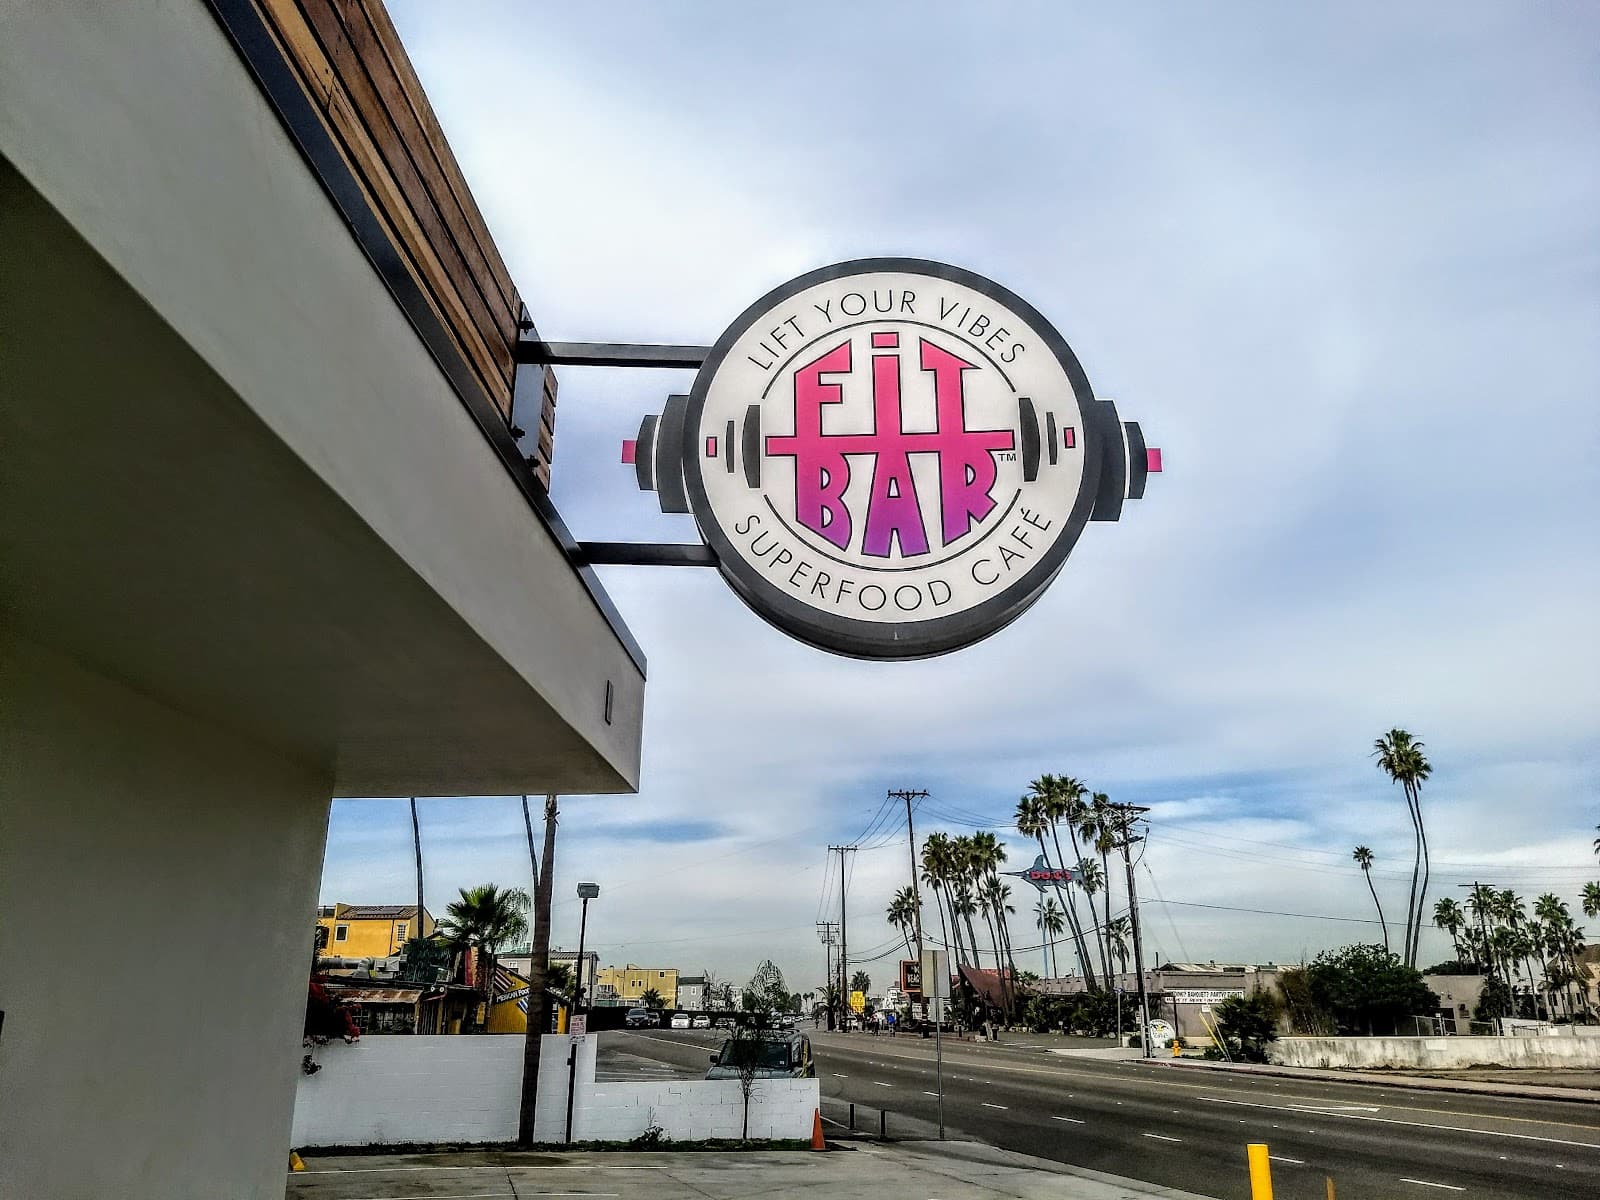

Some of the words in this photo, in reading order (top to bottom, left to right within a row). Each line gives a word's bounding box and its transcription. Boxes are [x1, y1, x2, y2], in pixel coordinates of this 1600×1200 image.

[747, 315, 806, 371] LIFT
[814, 290, 916, 324] YOUR
[939, 296, 1025, 366] VIBES
[793, 449, 999, 559] BAR
[735, 514, 952, 612] SUPERFOOD
[971, 507, 1052, 586] CAFÉ
